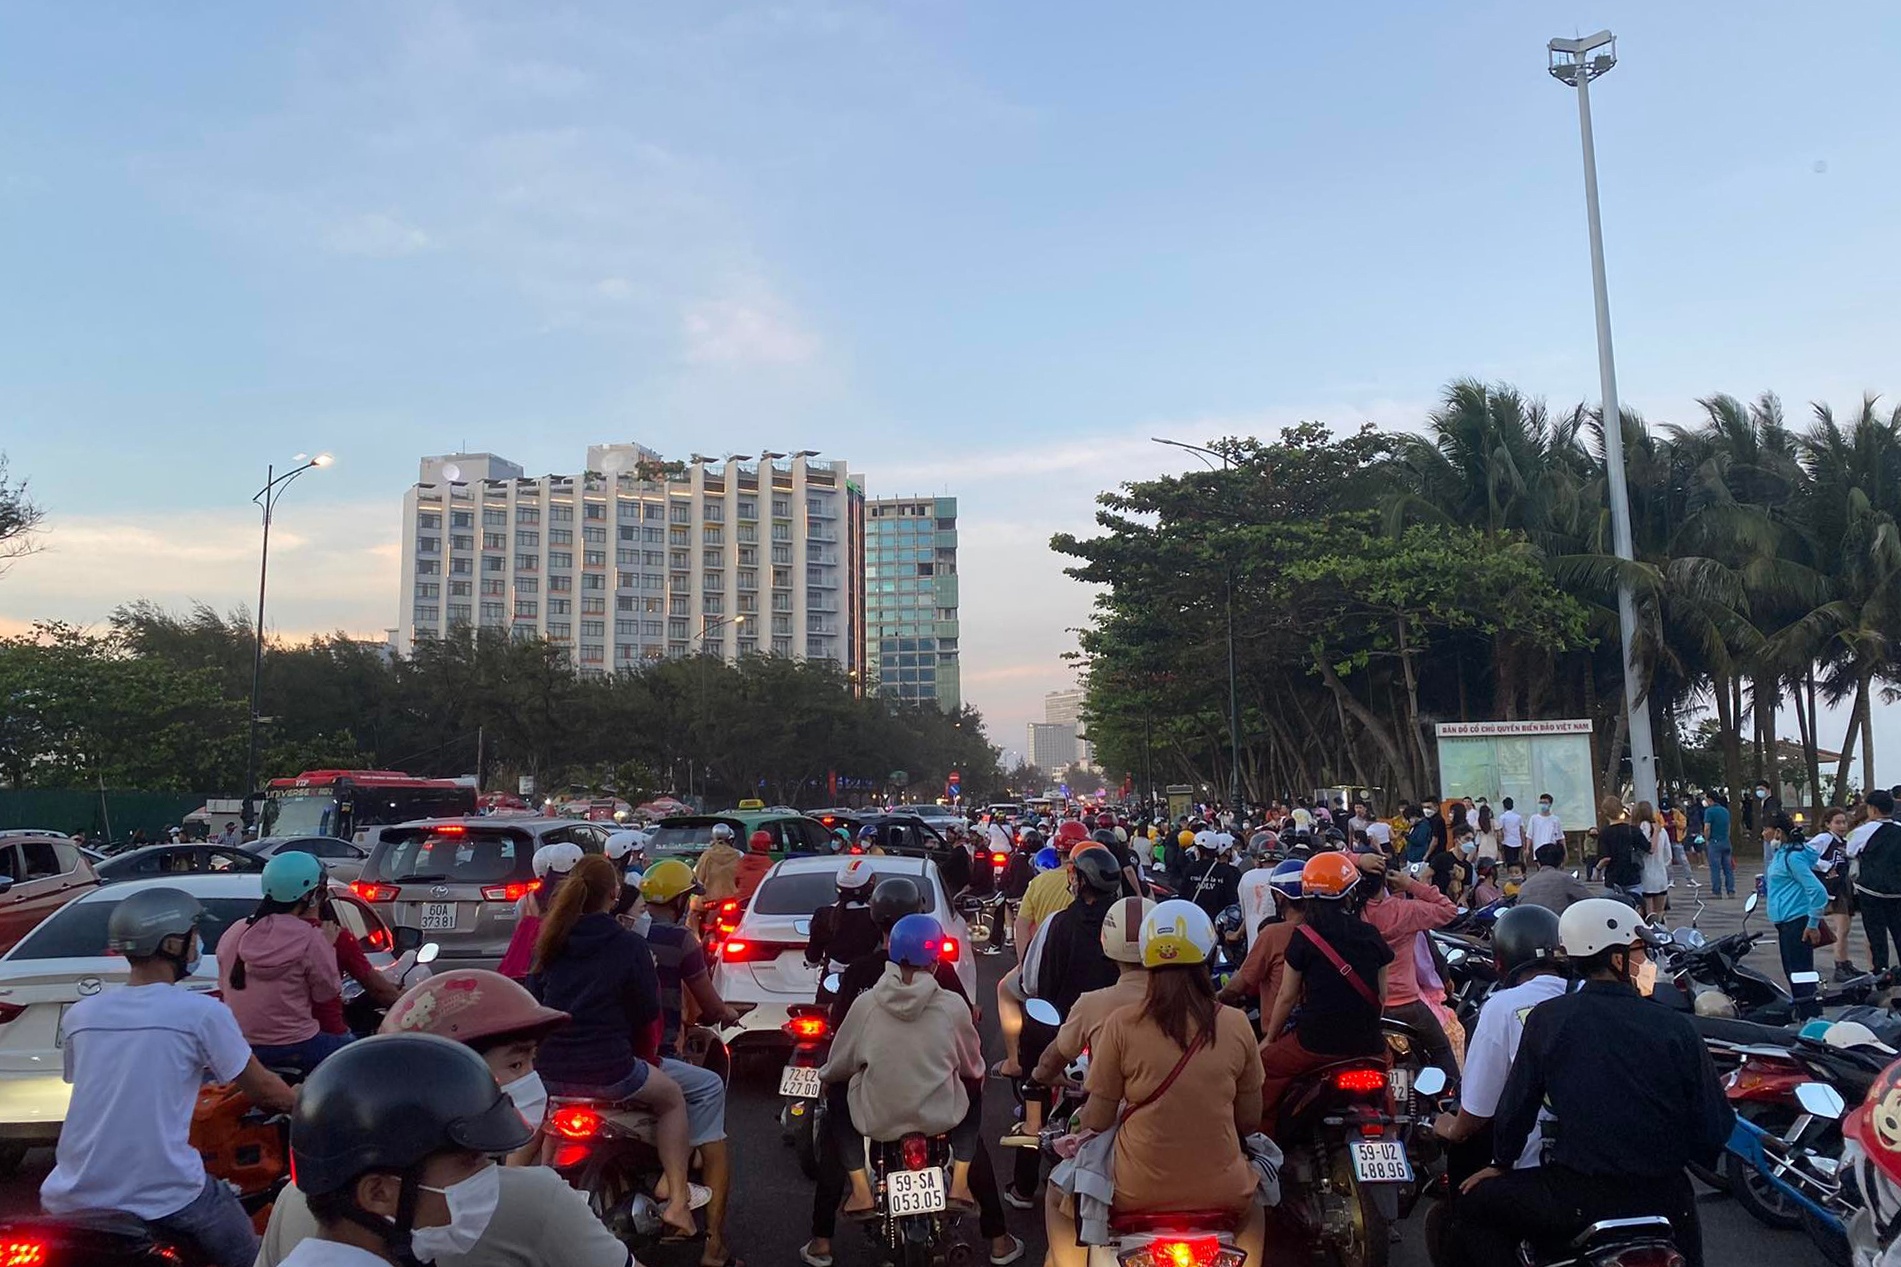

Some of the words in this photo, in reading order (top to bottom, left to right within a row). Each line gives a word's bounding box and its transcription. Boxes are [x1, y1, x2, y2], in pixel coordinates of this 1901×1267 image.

[295, 779, 310, 787] VIP
[429, 904, 448, 916] 60A
[788, 1068, 817, 1083] 72-C2
[782, 1081, 818, 1096] 427.00
[1359, 1144, 1398, 1160] 59-U2
[1360, 1162, 1405, 1179] 488.96
[895, 1171, 935, 1192] 59-SA
[892, 1190, 942, 1212] 053.05
